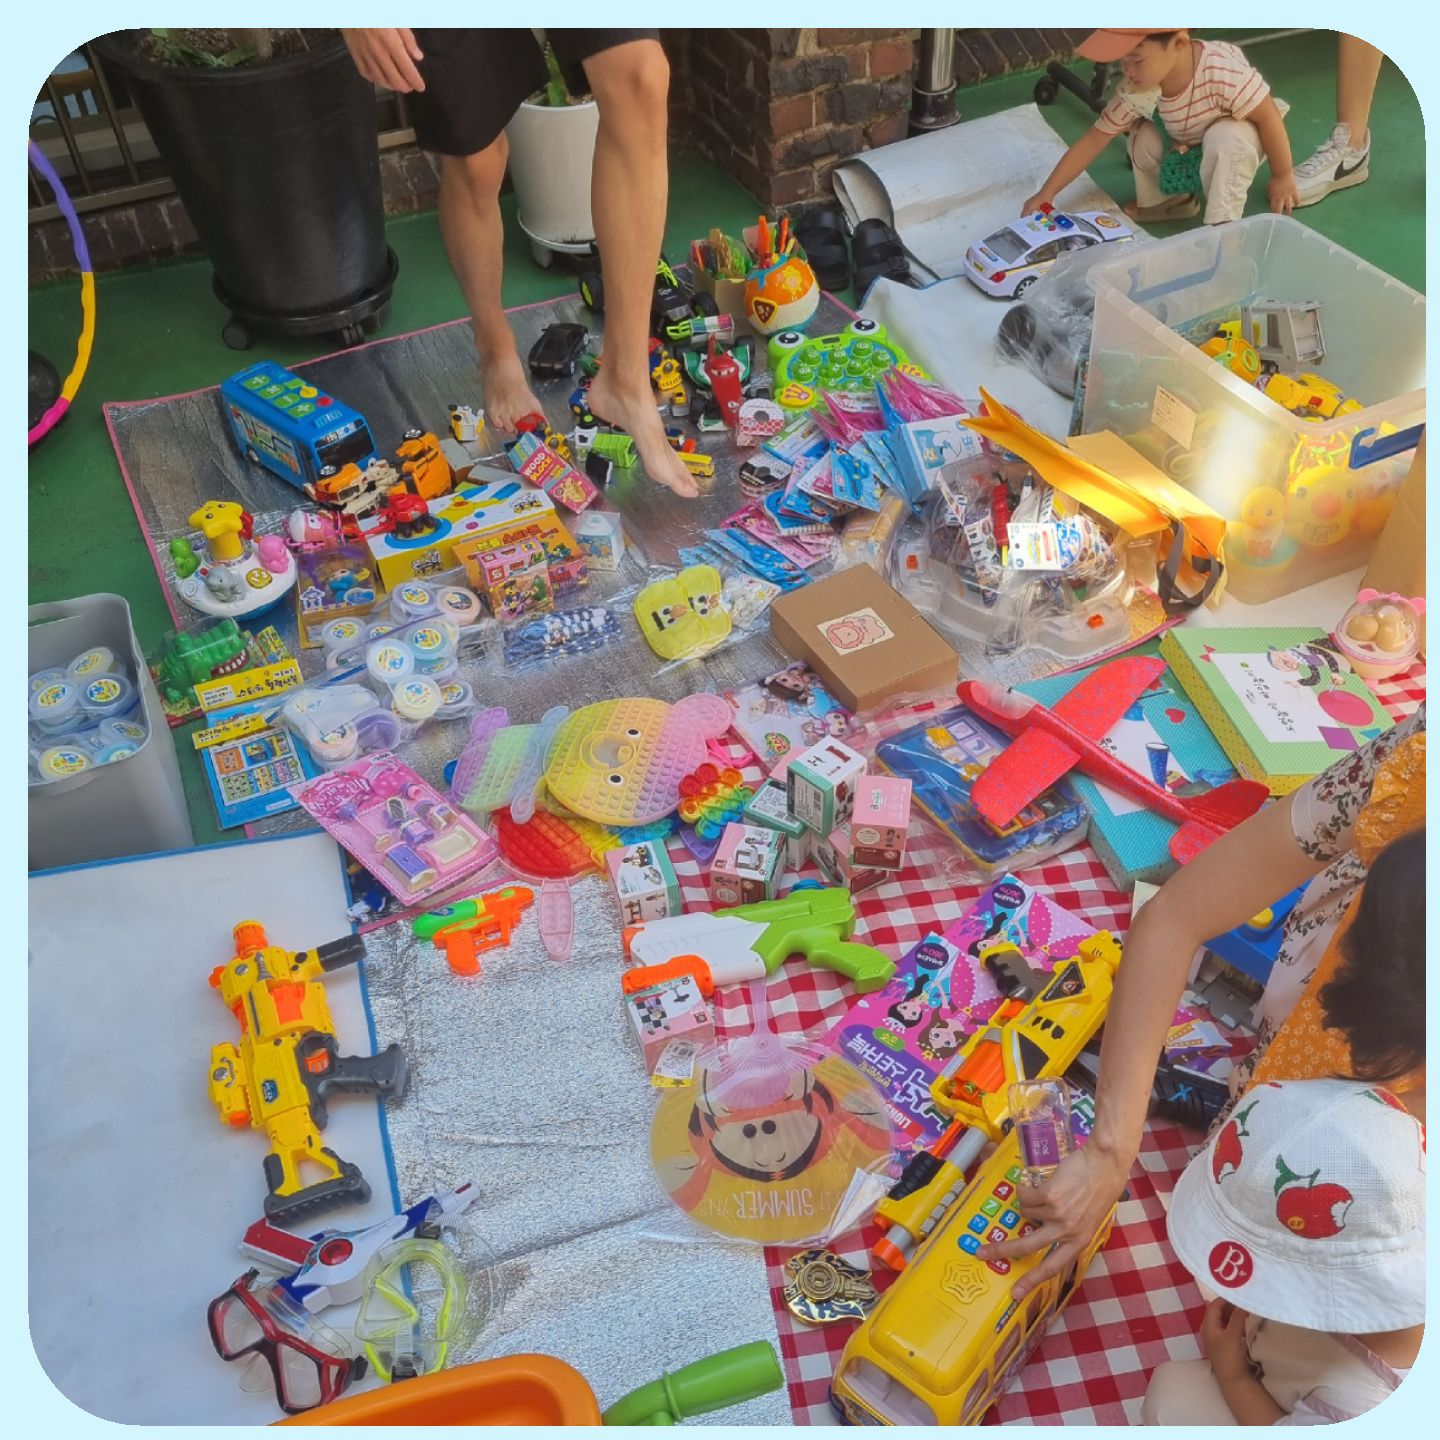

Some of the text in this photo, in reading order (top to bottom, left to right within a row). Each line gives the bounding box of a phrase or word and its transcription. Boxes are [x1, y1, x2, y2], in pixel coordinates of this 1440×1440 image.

[522, 452, 546, 475] WOOD
[847, 1033, 908, 1079] 스티커북
[997, 1185, 1010, 1197] 4
[732, 1187, 814, 1218] SUMMER
[985, 1201, 998, 1212] 7
[1005, 1212, 1016, 1225] 8
[991, 1228, 1005, 1242] 10
[1213, 1245, 1246, 1281] B
